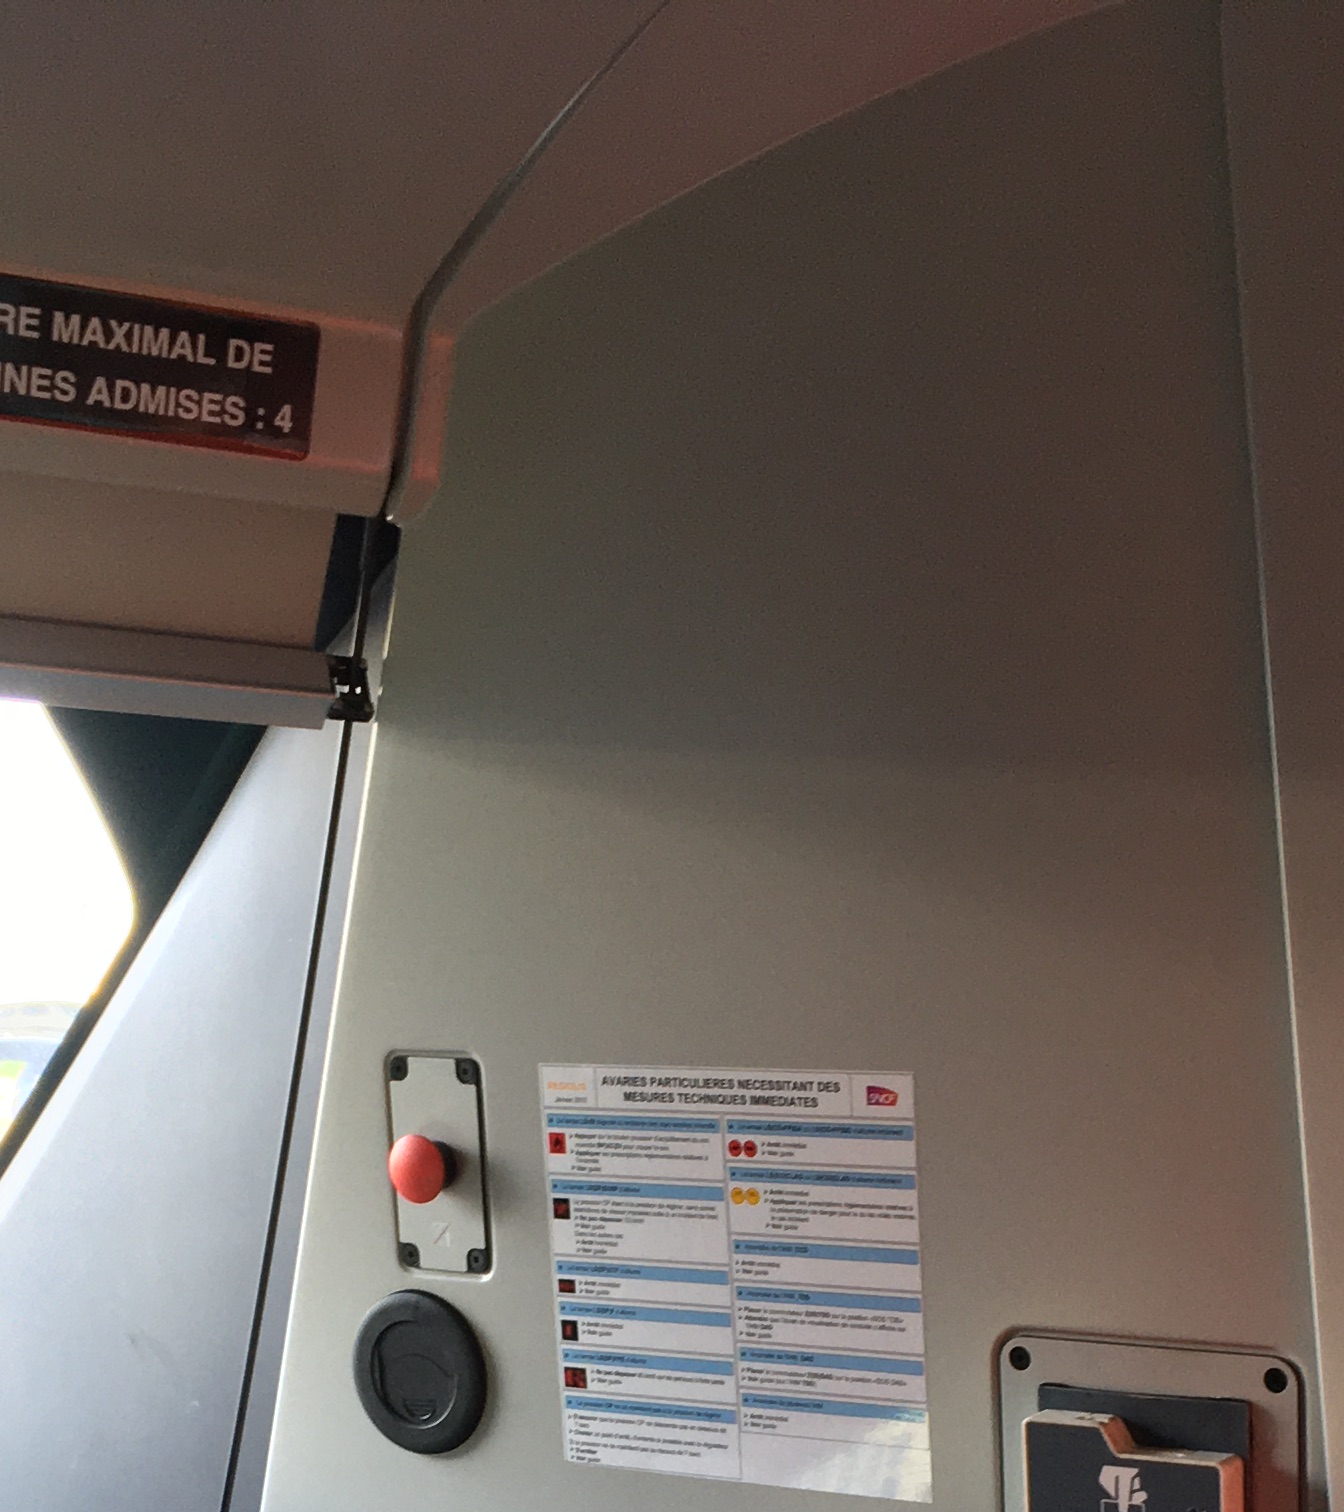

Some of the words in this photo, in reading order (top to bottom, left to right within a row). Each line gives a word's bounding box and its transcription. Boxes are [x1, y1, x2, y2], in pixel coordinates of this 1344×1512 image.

[52, 311, 216, 364] MAXIMAL
[226, 338, 274, 373] DE
[87, 376, 247, 426] ADMISES
[601, 1076, 647, 1088] AVARIES
[649, 1077, 735, 1091] PARTICULIERES
[737, 1079, 815, 1092] NECESSITANT
[817, 1081, 841, 1093] DES
[623, 1091, 674, 1104] MESURES
[677, 1092, 747, 1106] TECHNIQUES
[749, 1094, 819, 1108] IMMEDIATES
